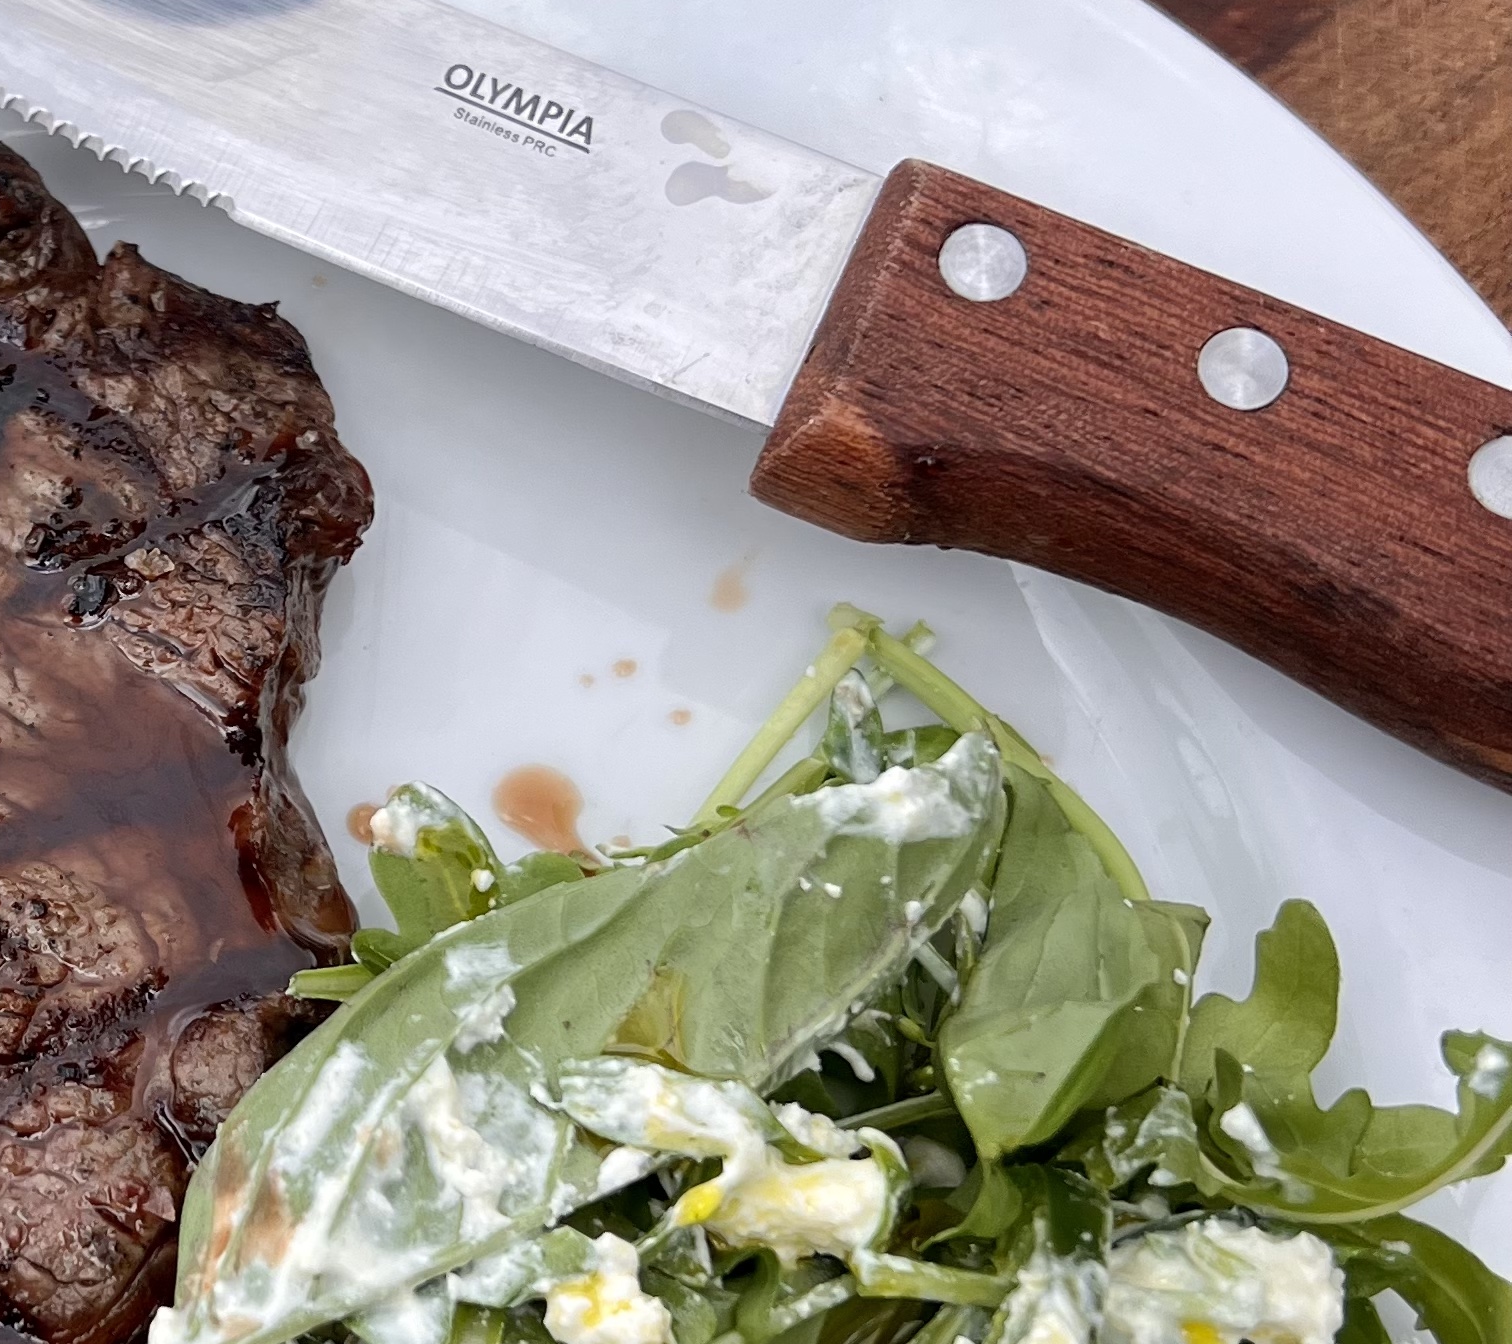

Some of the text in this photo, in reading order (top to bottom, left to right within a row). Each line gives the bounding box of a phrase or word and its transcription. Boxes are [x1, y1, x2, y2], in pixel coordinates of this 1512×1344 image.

[443, 63, 595, 146] OLYMPIA
[453, 106, 558, 158] Stainless PRC
